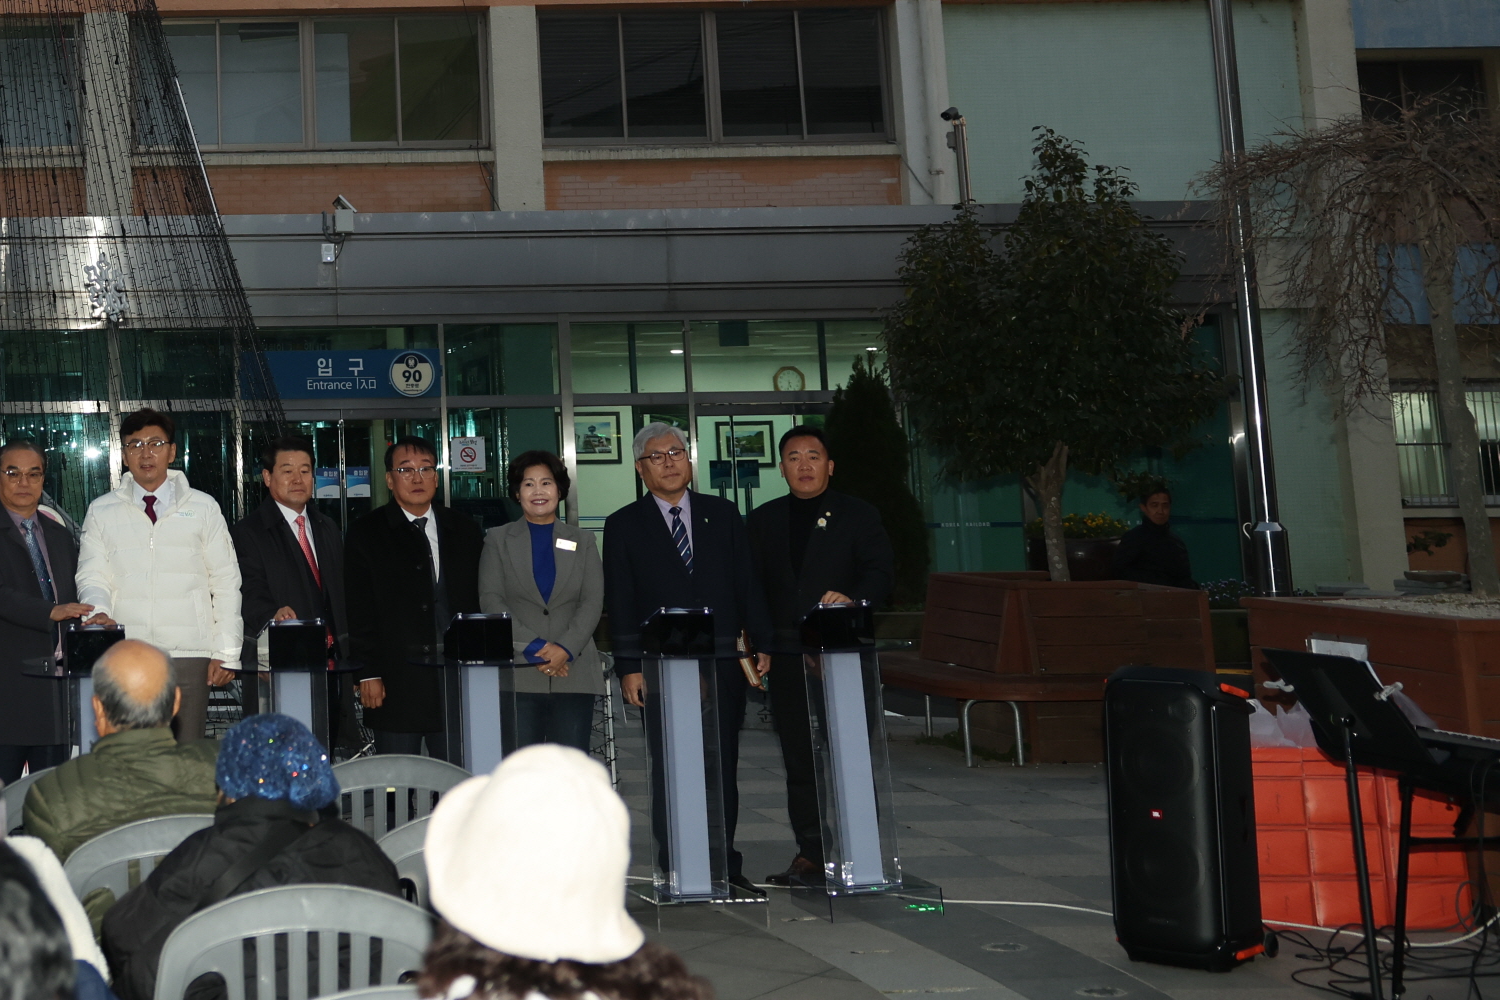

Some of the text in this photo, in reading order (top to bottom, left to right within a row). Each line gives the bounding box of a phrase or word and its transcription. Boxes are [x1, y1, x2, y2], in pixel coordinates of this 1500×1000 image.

[317, 357, 364, 377] 입구
[402, 369, 422, 383] 90
[306, 379, 352, 390] Entrance
[360, 379, 377, 390] 入口
